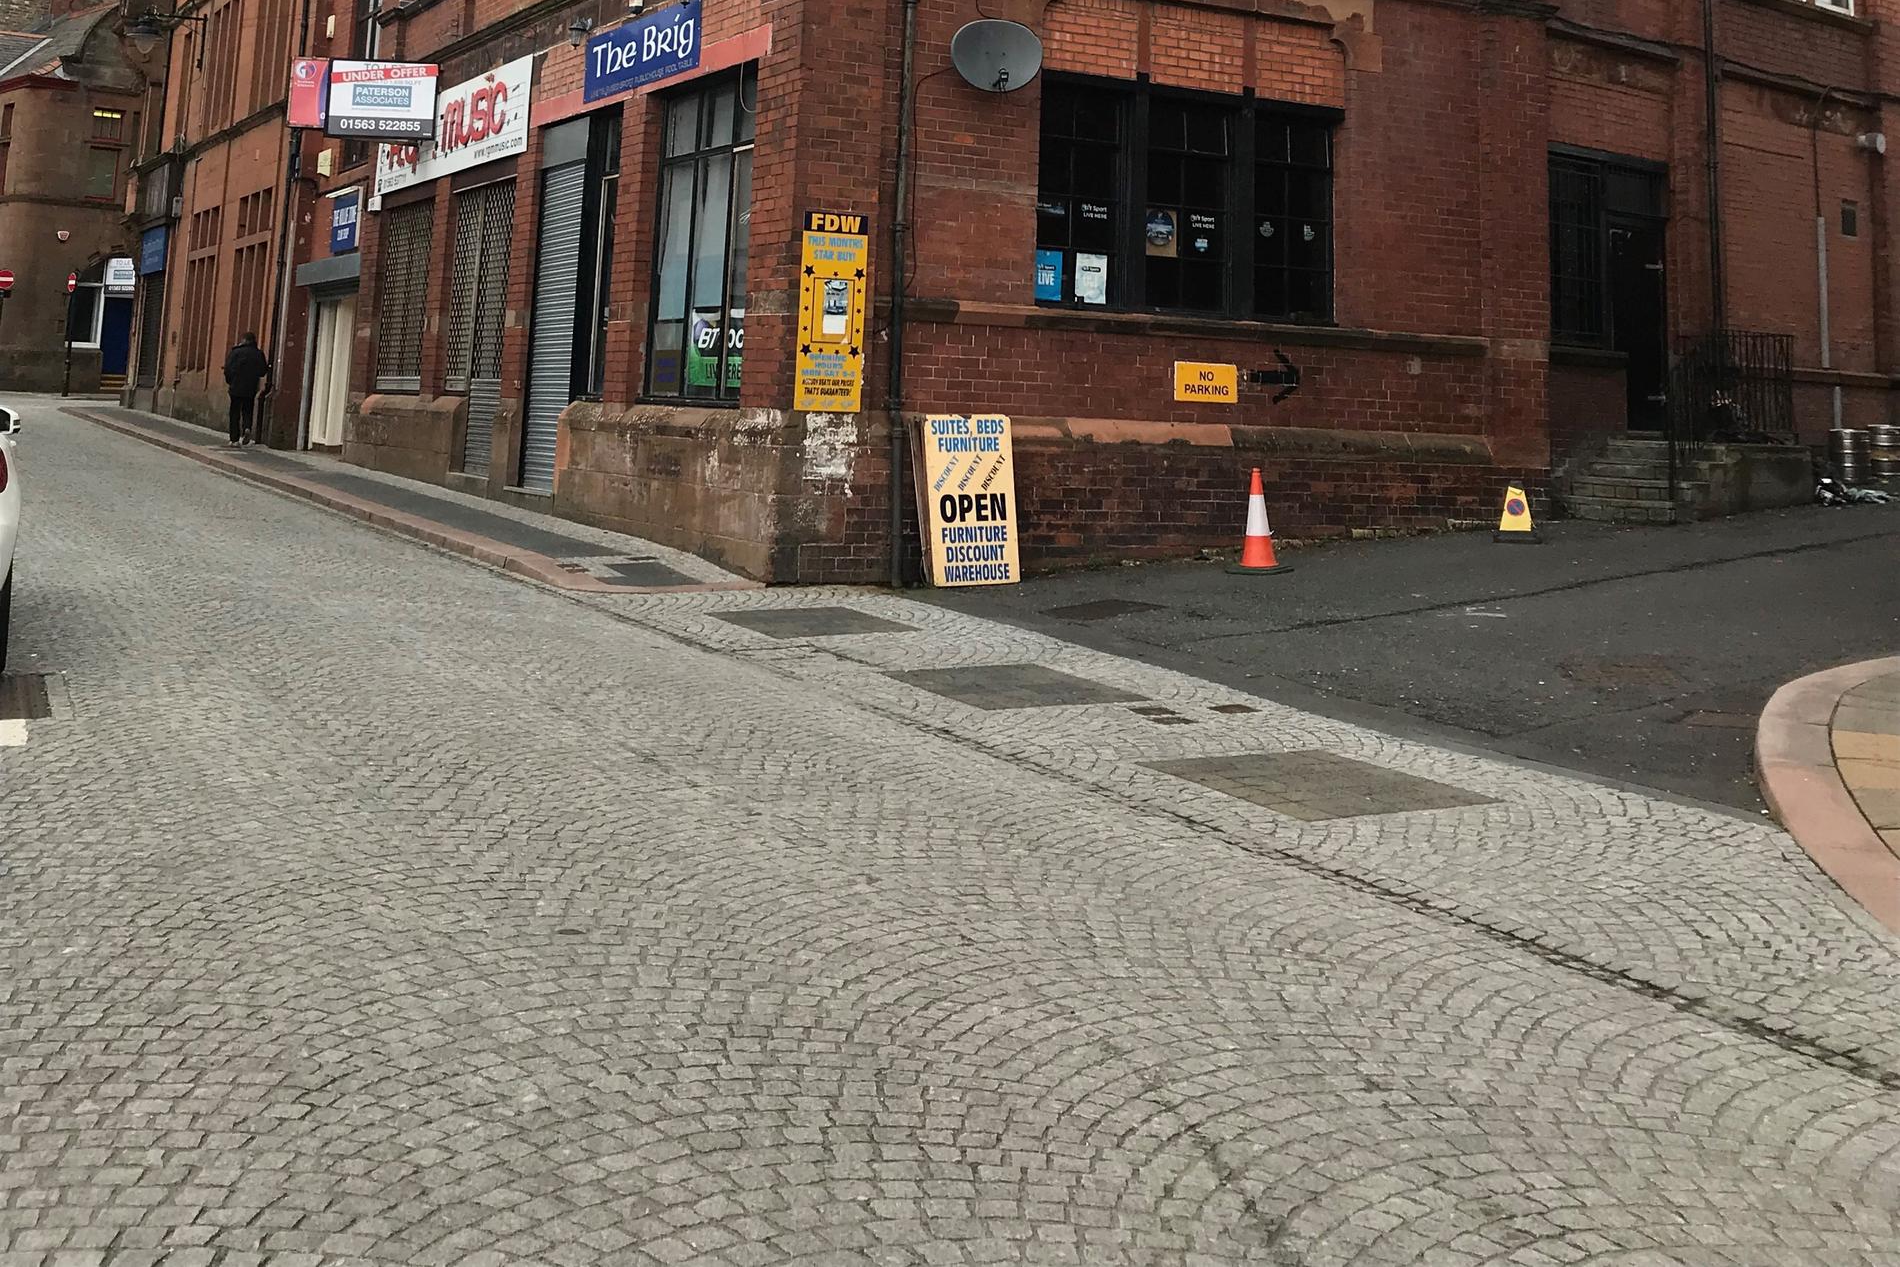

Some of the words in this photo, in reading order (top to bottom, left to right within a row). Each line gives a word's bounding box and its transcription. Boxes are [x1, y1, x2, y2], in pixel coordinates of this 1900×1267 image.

[593, 41, 637, 78] The
[342, 70, 384, 81] UNDER
[390, 67, 427, 78] OFFER
[356, 86, 409, 97] PATERSON
[354, 95, 410, 106] ASSOCIATES
[340, 119, 375, 130] 01563
[378, 120, 421, 132] 522855
[811, 213, 861, 233] FDW
[808, 235, 826, 246] THIS
[829, 237, 864, 249] MONTHS
[814, 249, 834, 260] STAR
[1038, 273, 1055, 286] LIVE
[1199, 370, 1214, 382] NO
[1184, 384, 1229, 396] PARKING
[976, 419, 1004, 434] BEDS
[938, 437, 999, 452] FURNITURE
[934, 455, 959, 492] DISCOUNT
[957, 453, 982, 491] DISCOUNT
[981, 454, 1006, 491] DISCOUNT
[940, 493, 1007, 523] OPEN
[941, 525, 1008, 544] FURNITURE
[946, 544, 1005, 563] DISCOUNT
[944, 563, 1010, 582] WAREHOUSE
